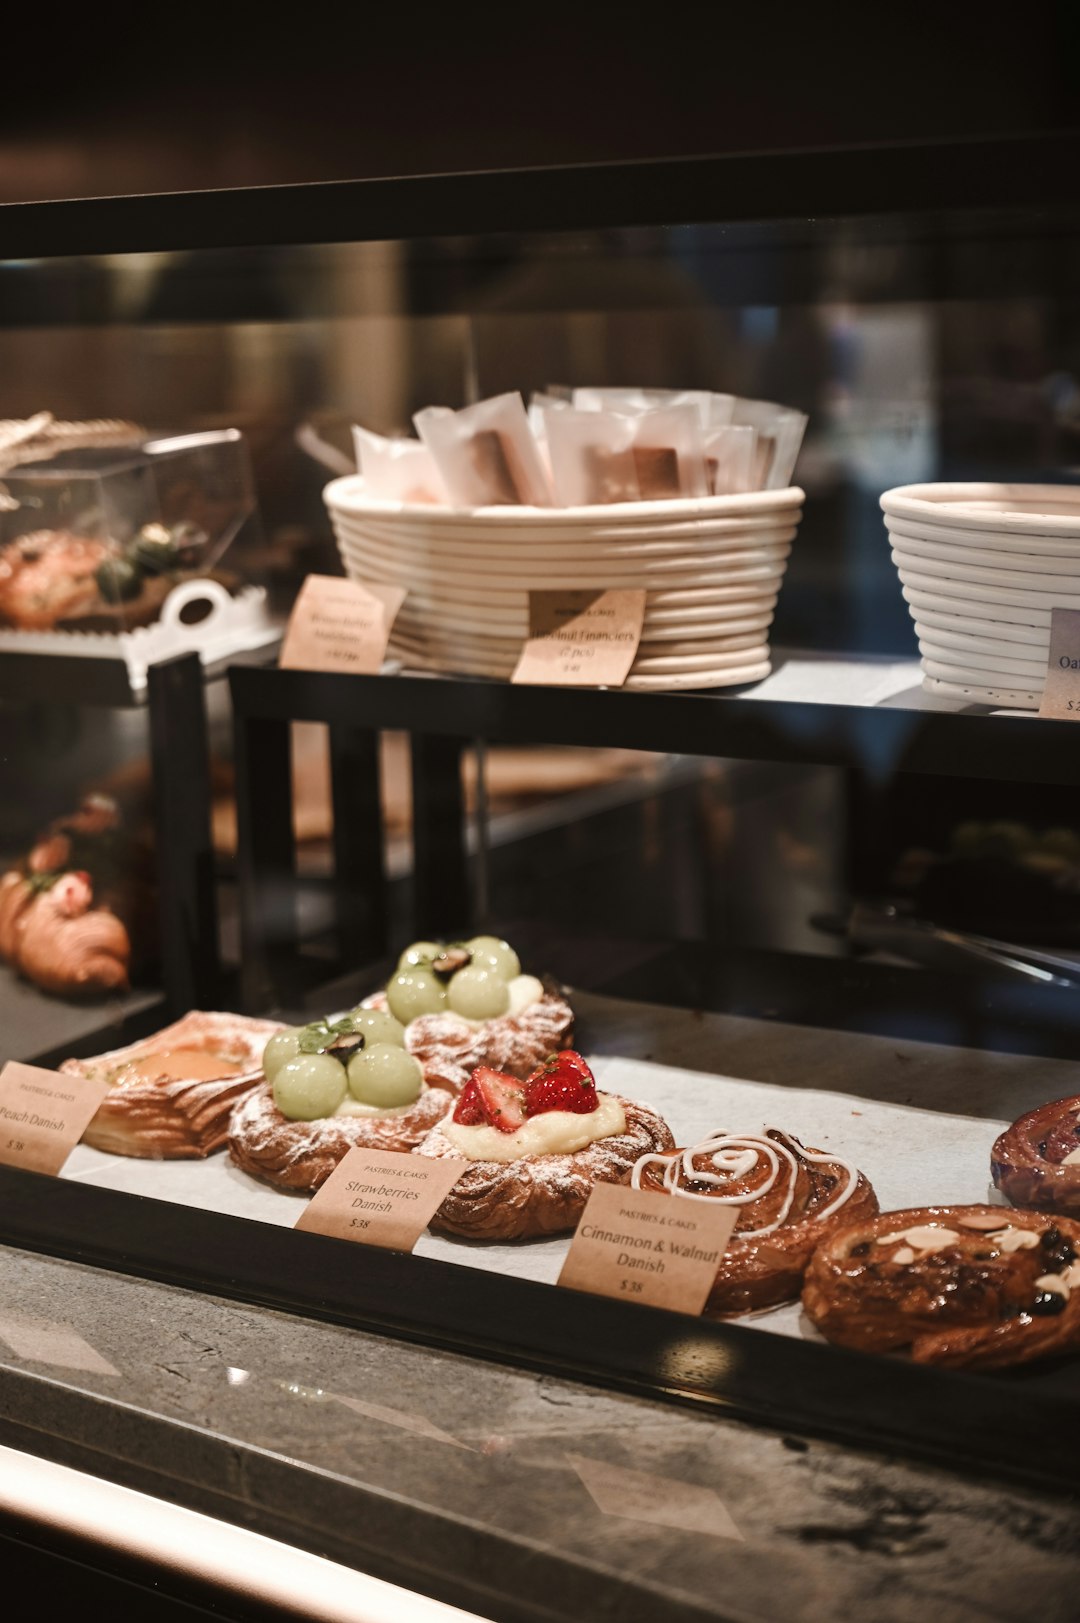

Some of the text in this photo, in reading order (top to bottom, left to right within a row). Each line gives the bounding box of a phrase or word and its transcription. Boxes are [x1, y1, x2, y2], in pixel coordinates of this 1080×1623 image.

[581, 630, 635, 641] Financiers
[1060, 656, 1080, 669] Oa
[29, 1113, 65, 1131] Danish
[363, 1165, 429, 1180] PASTRIES & CAKES
[345, 1180, 421, 1201] Strawberries
[351, 1197, 393, 1213] Danish
[619, 1208, 698, 1231] PASTRIES & CAKES
[580, 1224, 720, 1264] Cinnamon & Walnut
[616, 1252, 666, 1274] Danish
